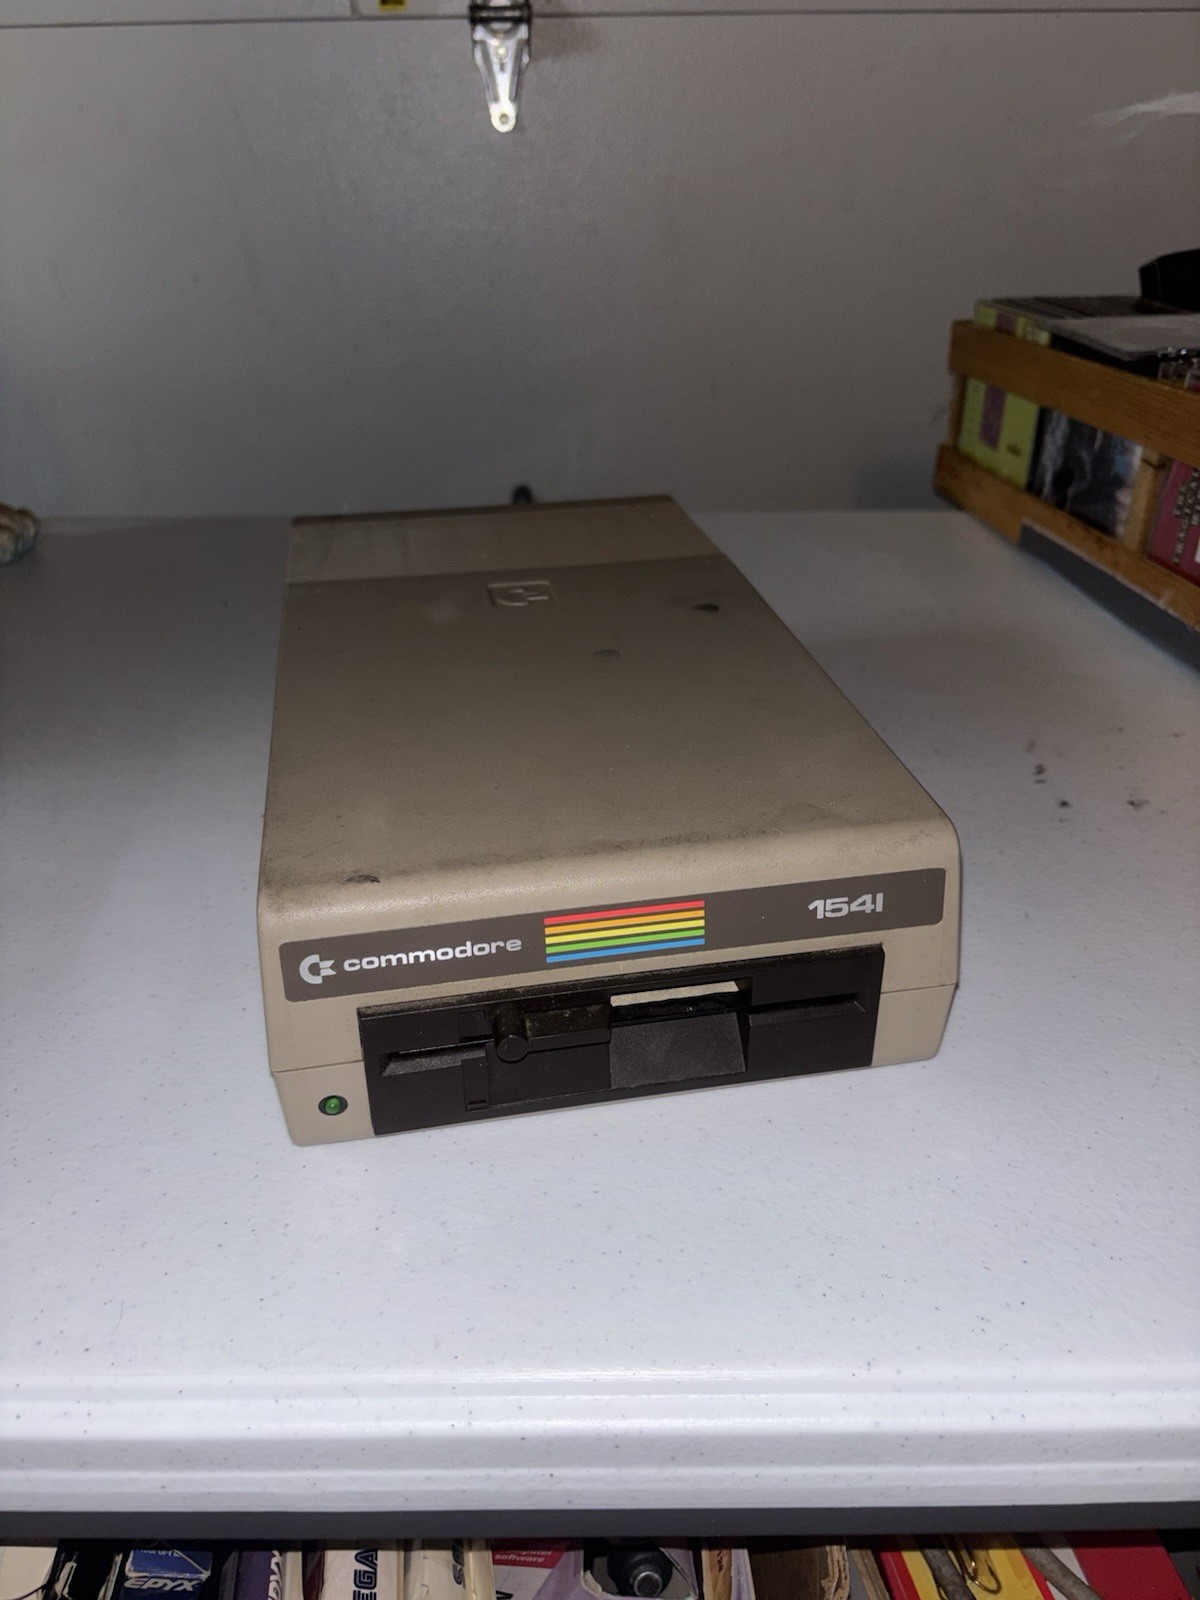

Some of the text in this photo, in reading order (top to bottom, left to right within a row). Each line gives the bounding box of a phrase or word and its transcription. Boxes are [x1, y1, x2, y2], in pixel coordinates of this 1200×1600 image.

[808, 892, 884, 920] 1541
[343, 938, 523, 972] commodore
[494, 1553, 545, 1563] software
[123, 1576, 200, 1592] EPYX
[353, 1547, 378, 1600] EGA
